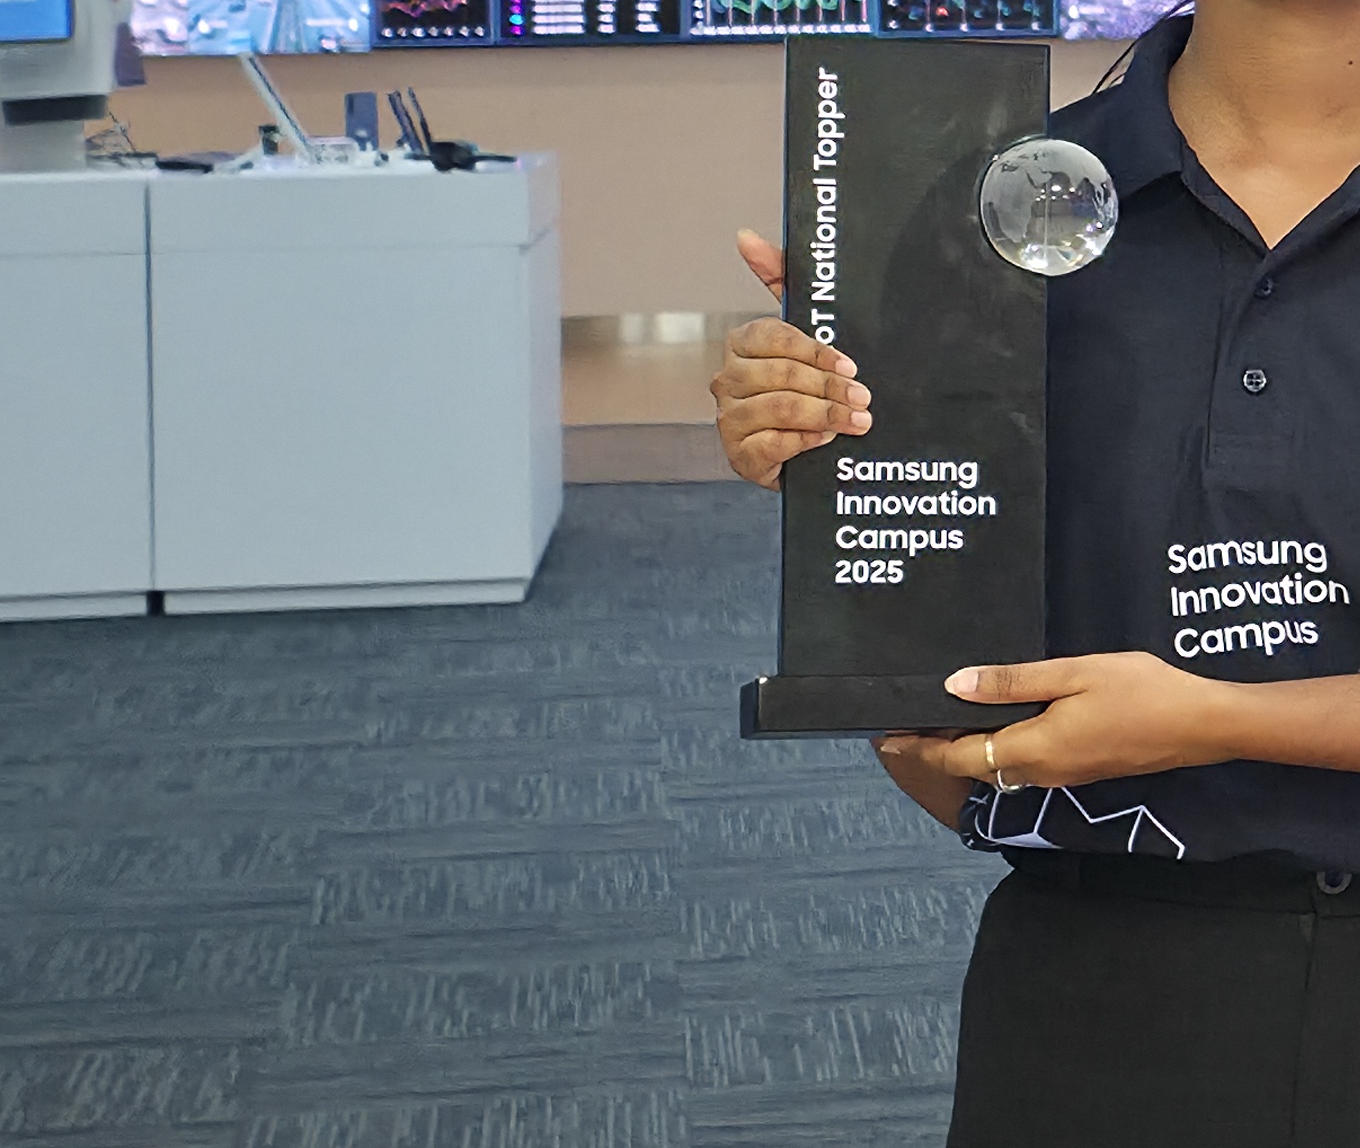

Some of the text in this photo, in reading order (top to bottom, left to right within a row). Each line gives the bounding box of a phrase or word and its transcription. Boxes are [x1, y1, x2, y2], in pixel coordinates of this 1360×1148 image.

[811, 66, 846, 346] oT National Topper
[836, 457, 979, 489] Samsung
[836, 490, 997, 516] Innovation
[835, 525, 965, 557] Campus
[1167, 539, 1329, 575] Samsung
[834, 559, 904, 584] 2025
[1170, 572, 1352, 617] Innovation
[1173, 619, 1320, 659] Campus
